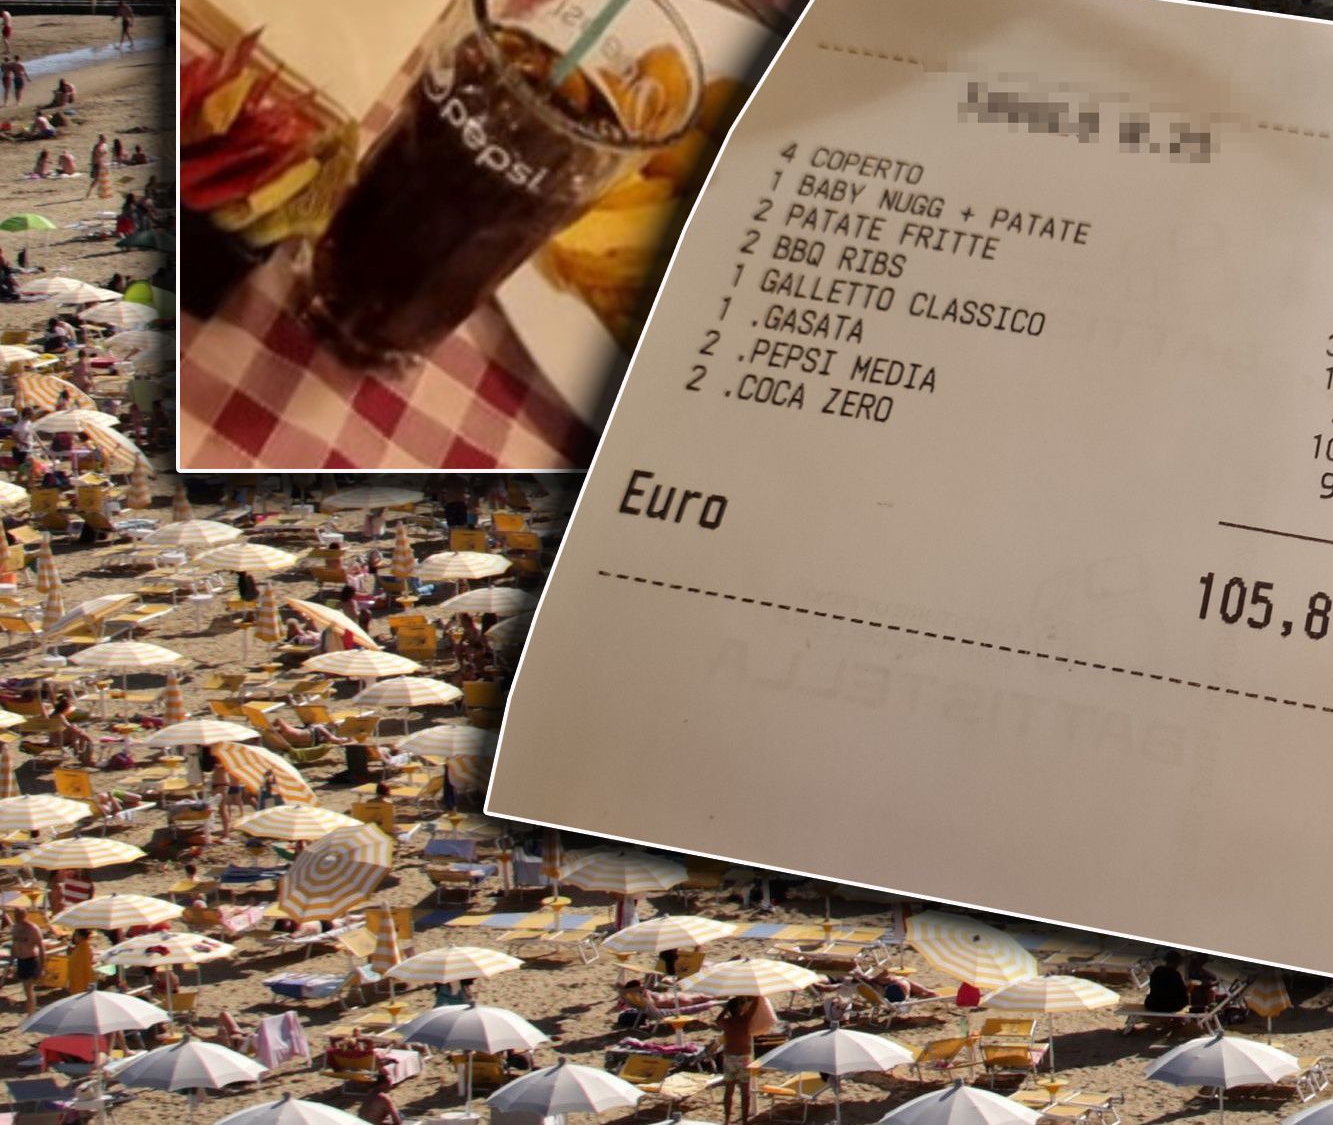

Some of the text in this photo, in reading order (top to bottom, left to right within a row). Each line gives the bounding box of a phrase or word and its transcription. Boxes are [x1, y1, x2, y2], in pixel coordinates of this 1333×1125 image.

[440, 97, 548, 194] pepsi
[780, 142, 798, 163] 4
[811, 146, 924, 186] COPERTO
[752, 198, 773, 223] 2
[785, 203, 887, 242] PATATE
[900, 223, 1000, 261] FRITTE
[771, 170, 784, 192] 1
[797, 174, 866, 205] BABY
[879, 189, 945, 220] NUGG
[961, 206, 975, 223] +
[990, 208, 1091, 245] PATATE
[739, 229, 760, 255] 2
[773, 235, 826, 268] BBQ
[838, 246, 908, 278] RIBS
[719, 296, 733, 322] 1
[751, 304, 864, 345] .GASATA
[732, 263, 745, 288] 1
[760, 268, 896, 312] GALLETTO
[909, 292, 1046, 337] CLASSICO
[699, 329, 720, 356] 2
[737, 338, 837, 377] .PEPSI
[850, 355, 937, 394] MEDIA
[685, 364, 708, 392] 2
[723, 373, 804, 411] .COCA
[821, 388, 894, 424] ZERO
[617, 468, 728, 531] Euro
